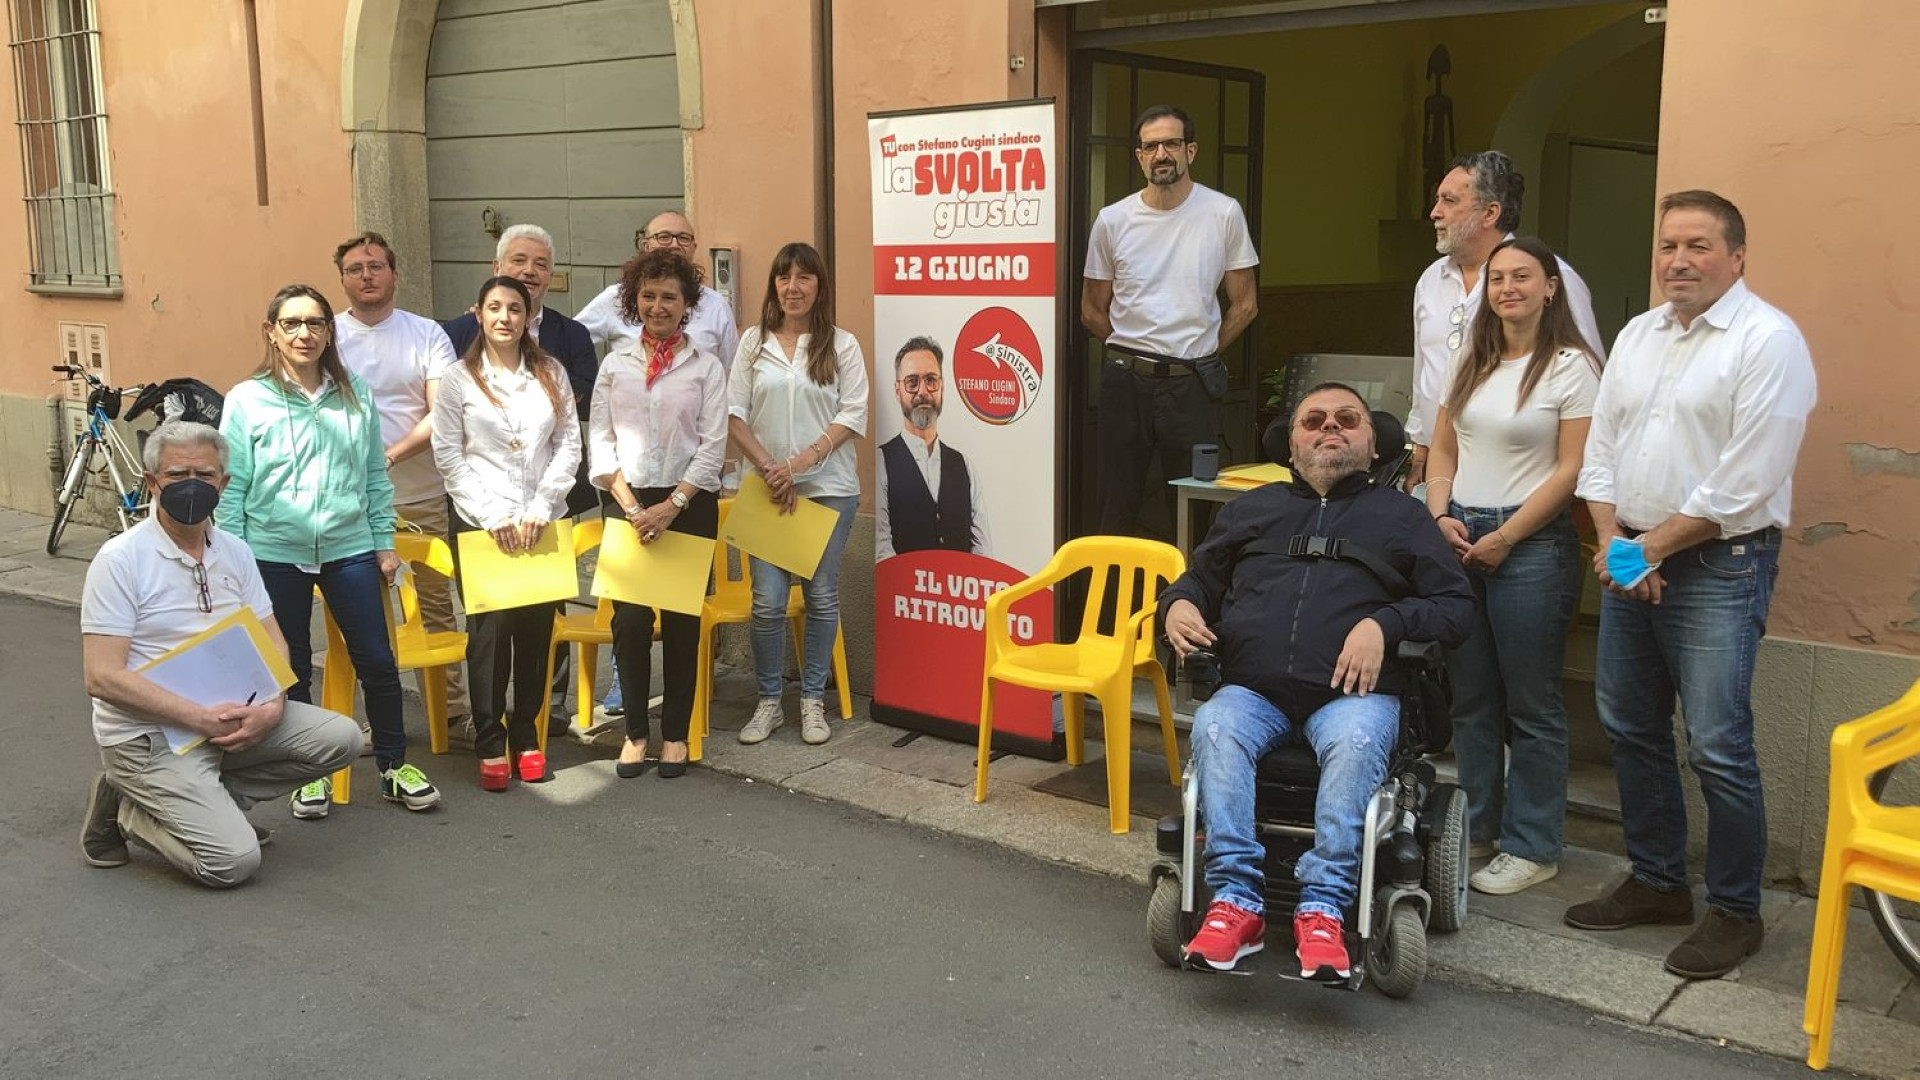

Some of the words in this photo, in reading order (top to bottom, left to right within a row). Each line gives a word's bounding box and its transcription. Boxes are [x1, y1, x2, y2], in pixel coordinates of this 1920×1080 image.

[898, 141, 916, 152] con
[918, 137, 959, 151] Stefano
[961, 134, 996, 151] Cugini
[998, 132, 1041, 146] sindaco
[915, 148, 1046, 196] SVOLTA
[934, 189, 1040, 239] giusta
[895, 256, 923, 281] 12
[929, 255, 1030, 281] GIUGNO
[959, 378, 989, 391] STEFANO
[991, 380, 1015, 392] CUGINI
[988, 392, 1016, 405] Sindaco
[915, 569, 942, 596] IL
[895, 594, 1034, 640] RITROVTO
